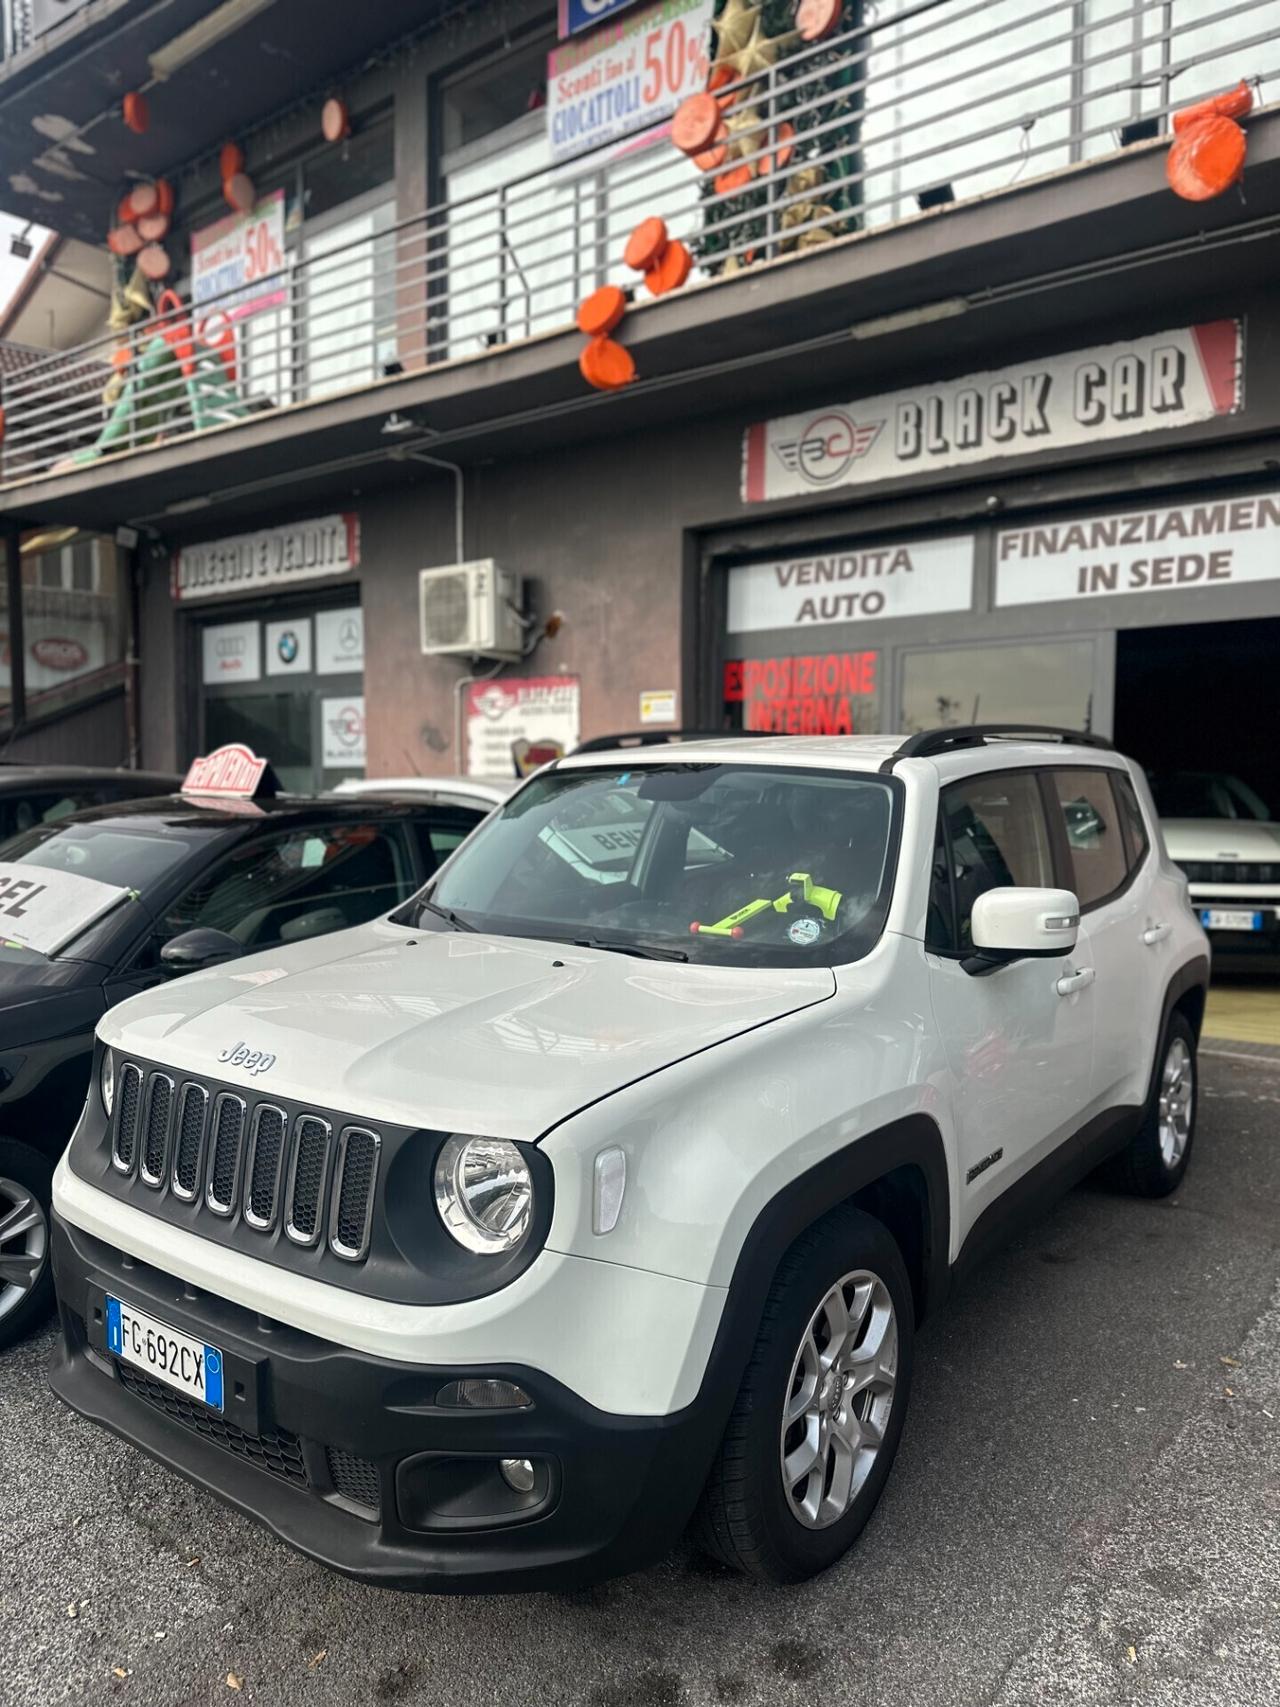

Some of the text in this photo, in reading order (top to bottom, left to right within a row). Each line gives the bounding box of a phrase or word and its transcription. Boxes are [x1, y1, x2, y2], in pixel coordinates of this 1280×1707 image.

[643, 20, 710, 103] 50%
[553, 75, 641, 144] GIOCATTOLI
[897, 373, 1053, 461] BLACK
[1073, 345, 1186, 424] CAR
[775, 548, 913, 588] VENDITA
[1077, 549, 1233, 594] IN SEDE
[796, 591, 886, 623] AUTO
[724, 650, 877, 702] ESPOSIZIONE
[749, 697, 852, 736] INTERNA
[216, 1040, 277, 1076] Jeep
